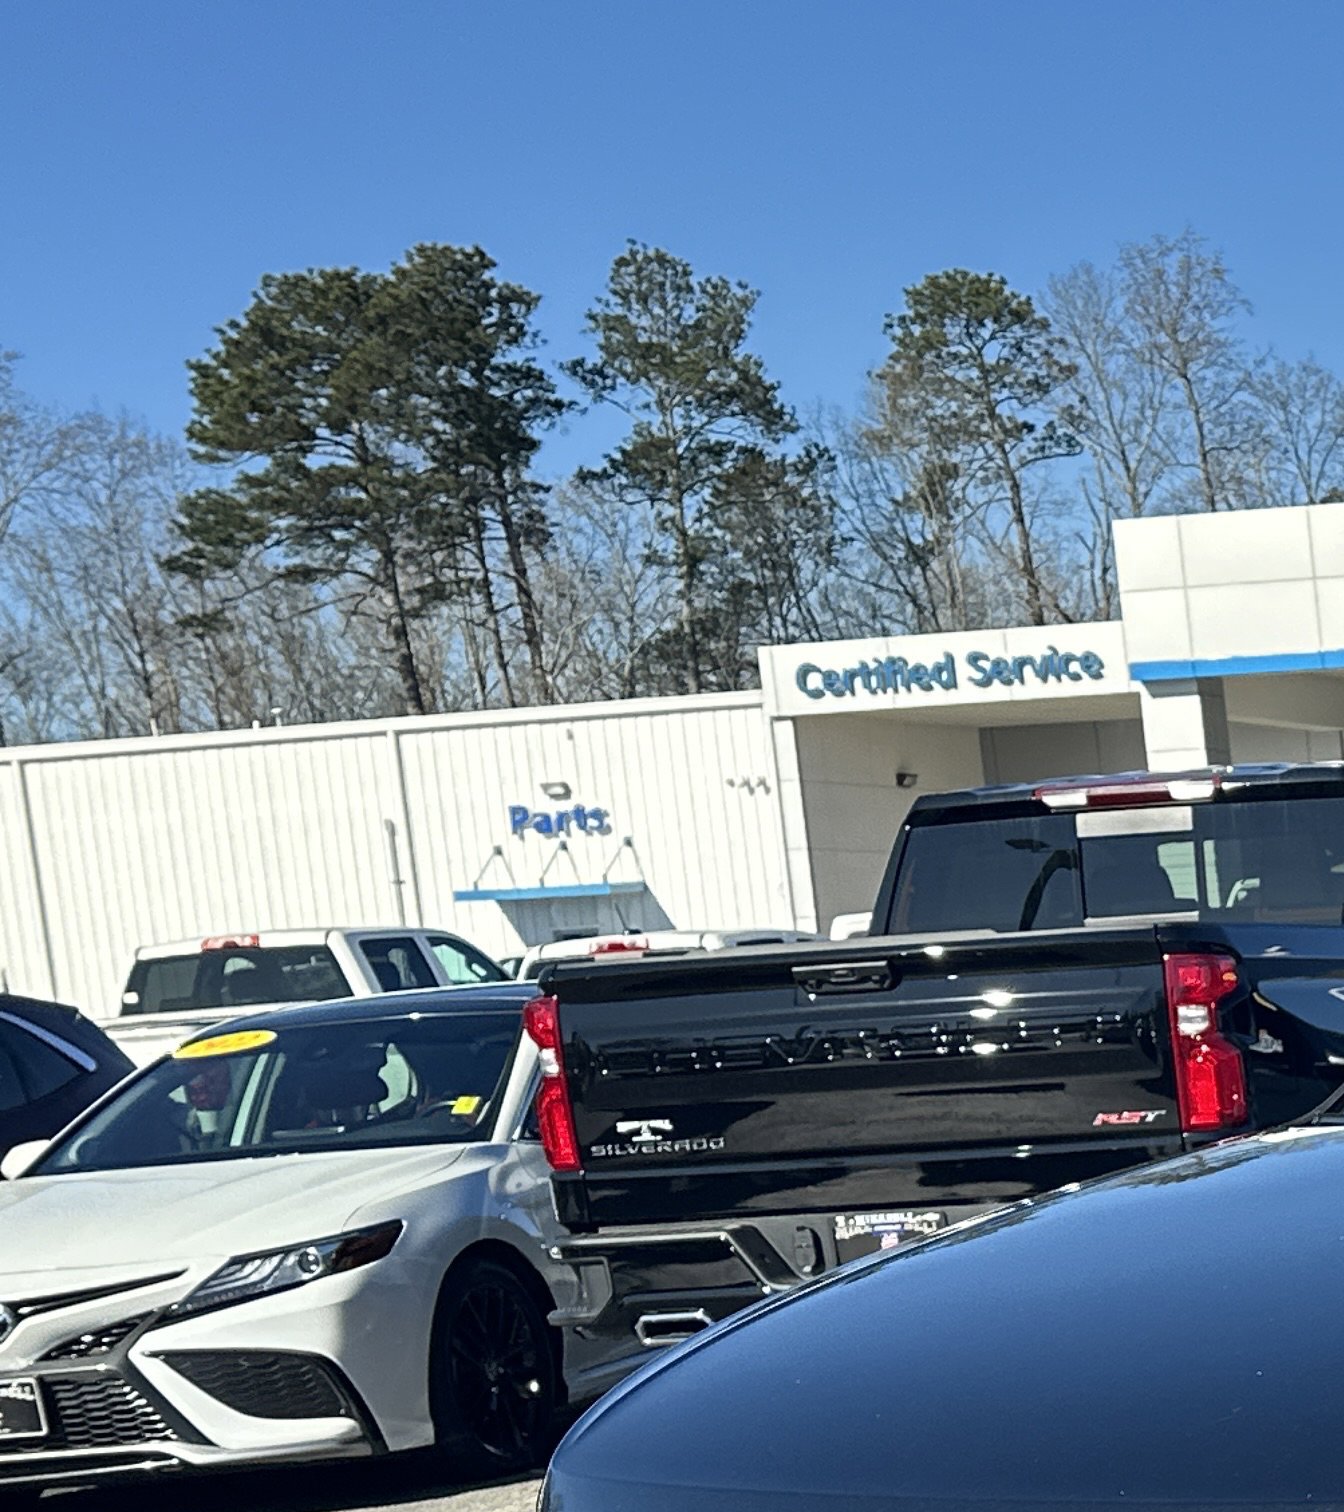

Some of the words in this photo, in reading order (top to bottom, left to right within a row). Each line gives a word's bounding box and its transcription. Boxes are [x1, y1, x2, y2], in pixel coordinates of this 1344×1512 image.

[796, 651, 957, 699] Certified
[966, 645, 1105, 688] Service
[508, 804, 611, 841] Parts
[1092, 1109, 1168, 1126] RST
[590, 1136, 726, 1157] SILVERADO
